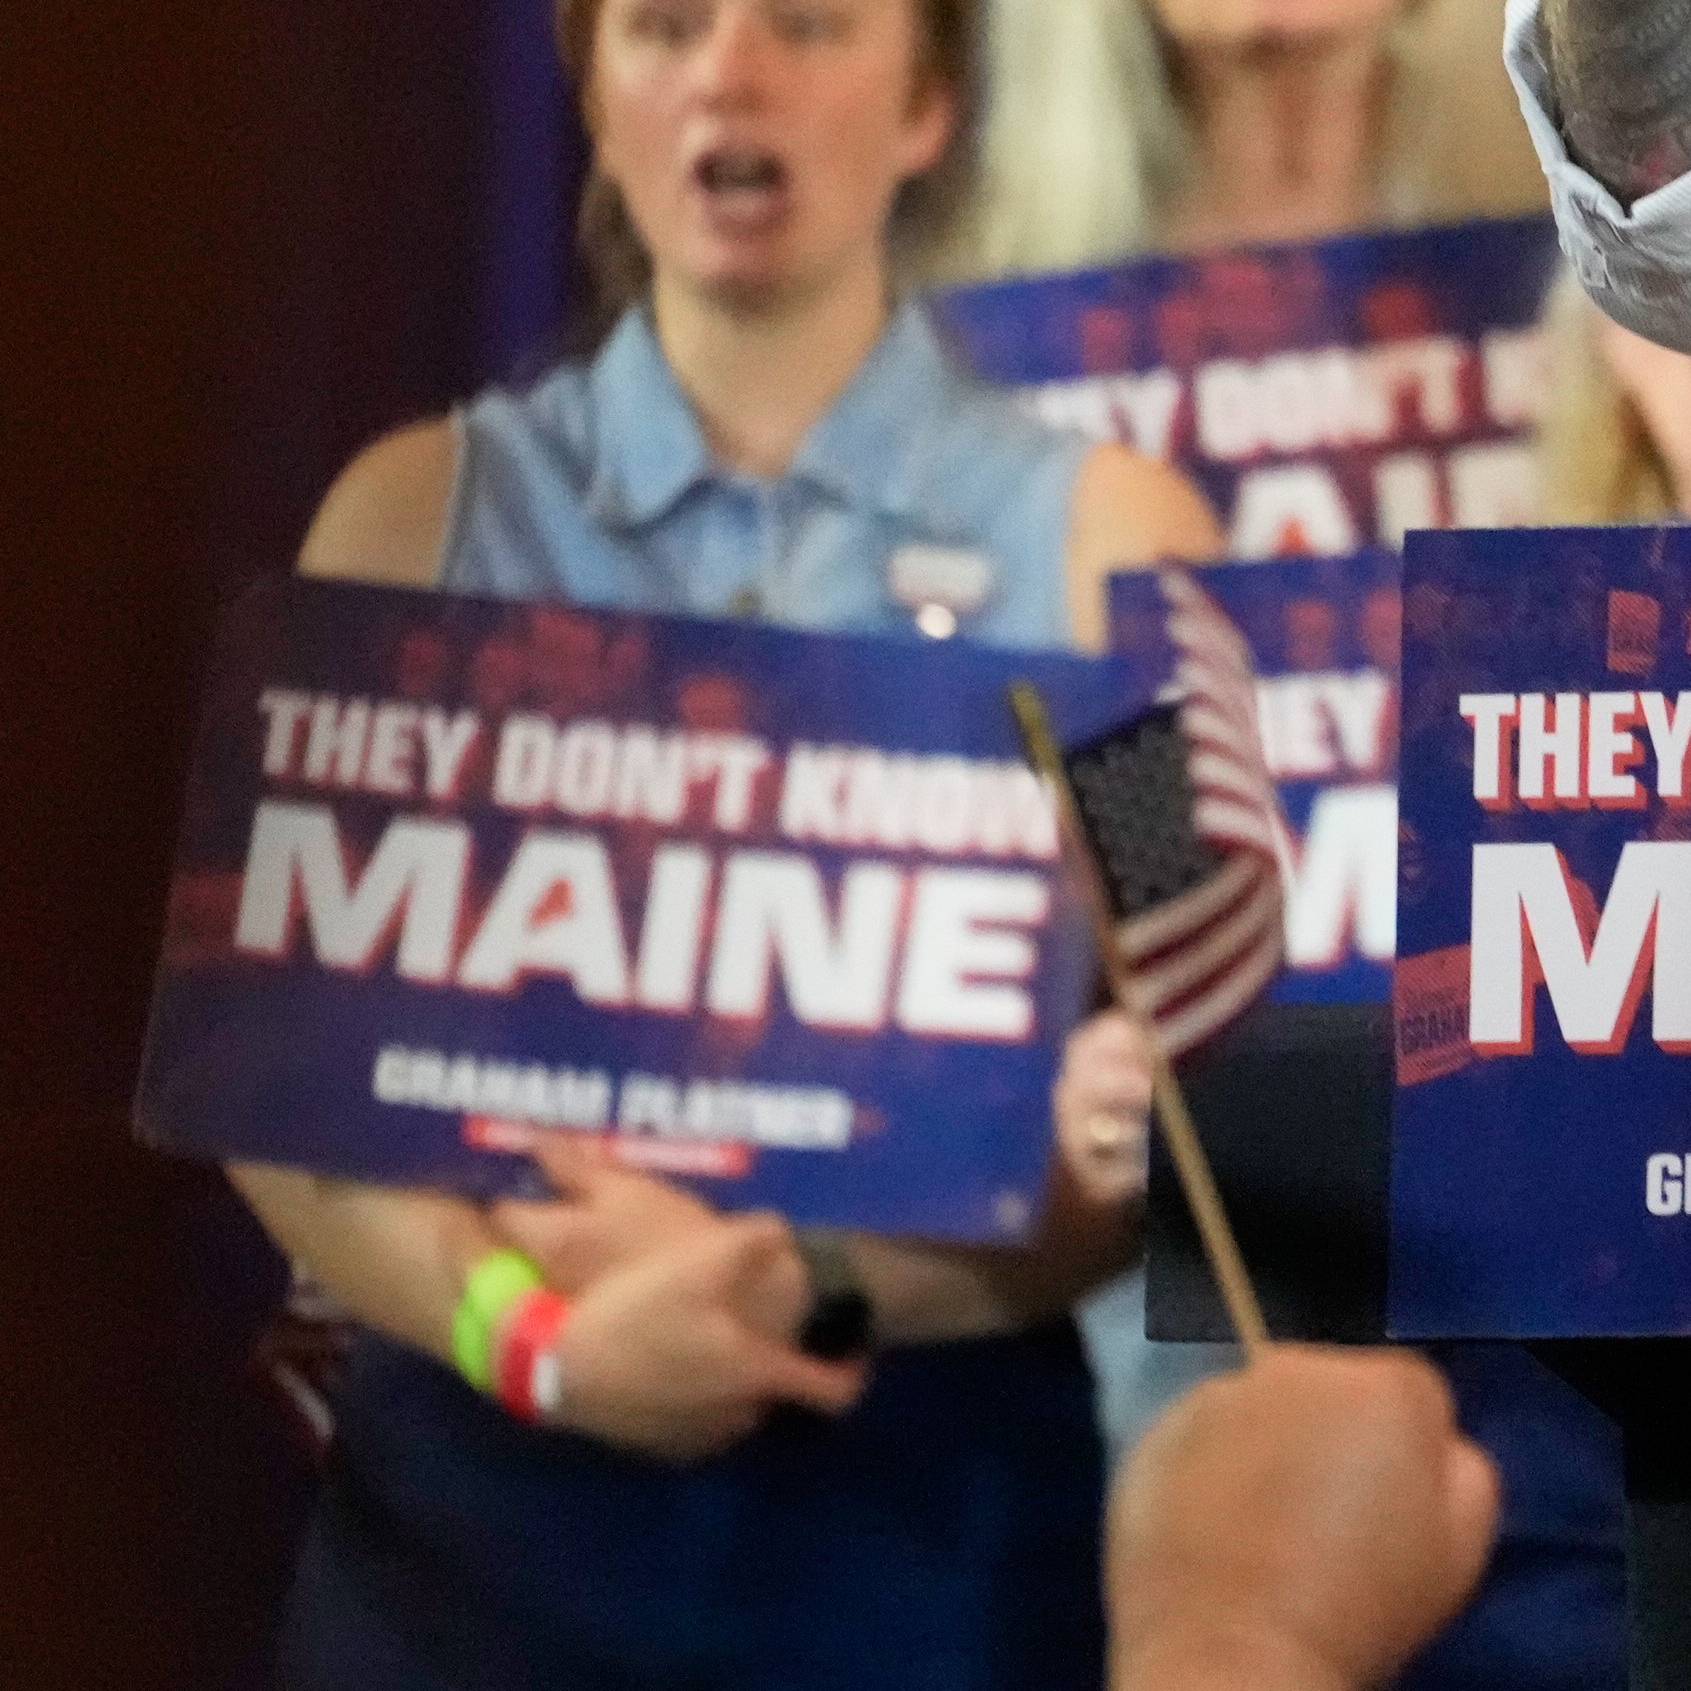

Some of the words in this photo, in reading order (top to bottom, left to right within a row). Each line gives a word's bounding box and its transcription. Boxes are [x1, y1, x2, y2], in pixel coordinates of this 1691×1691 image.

[260, 691, 478, 797] THEY
[493, 715, 774, 829] DON'T
[235, 799, 1049, 1037] MAINE
